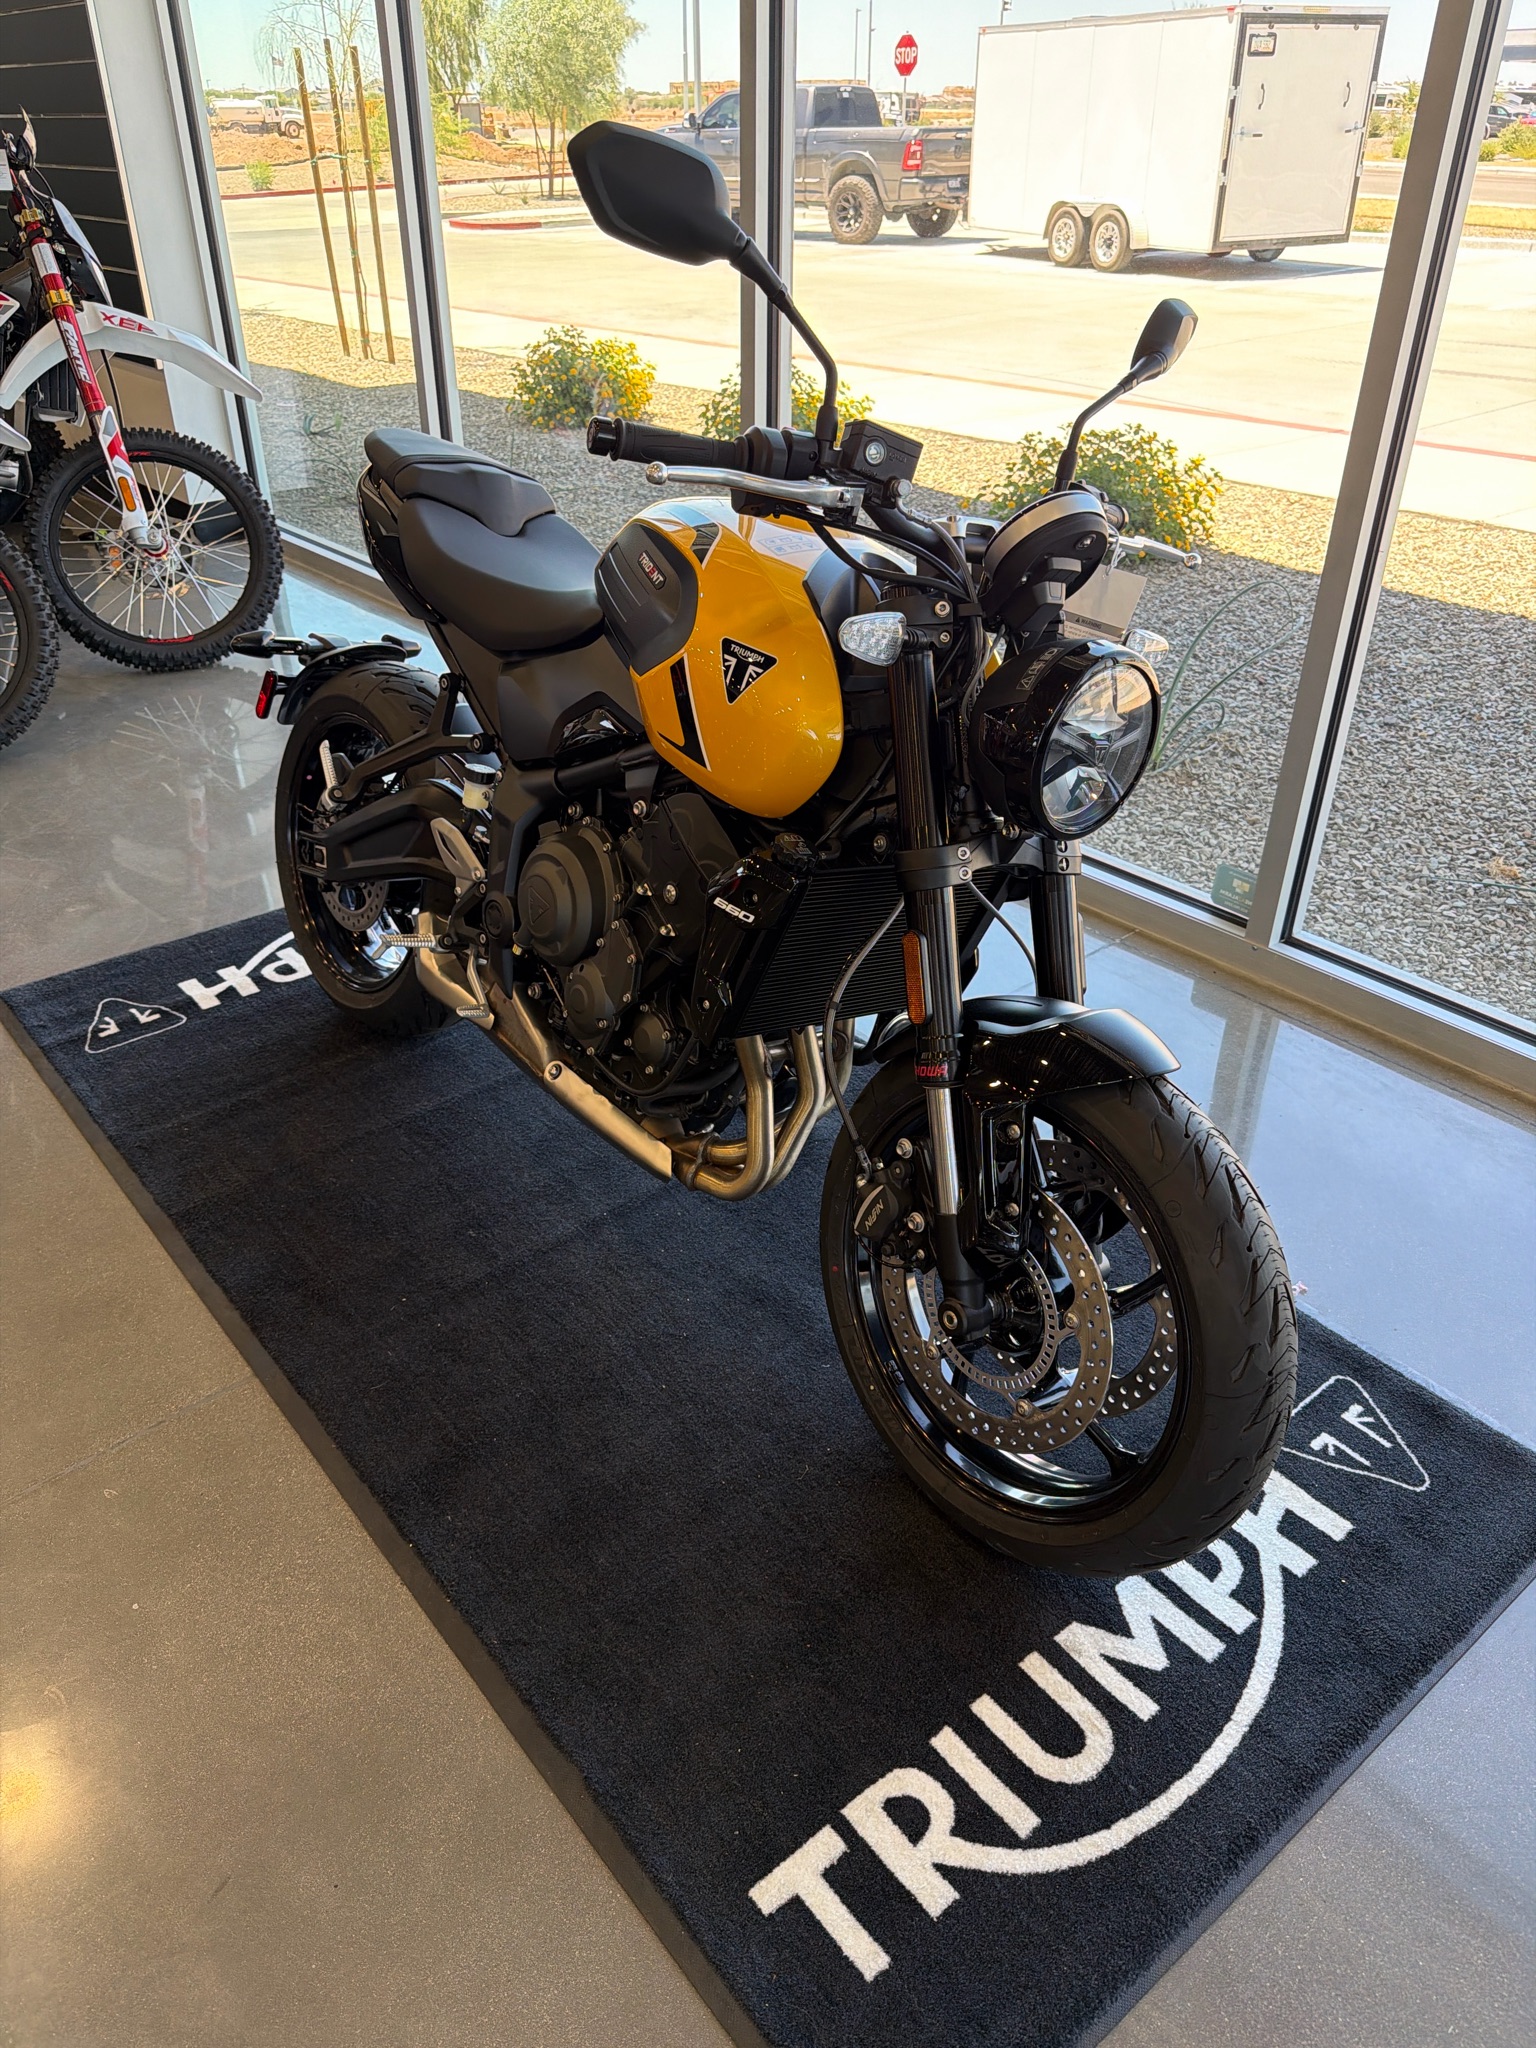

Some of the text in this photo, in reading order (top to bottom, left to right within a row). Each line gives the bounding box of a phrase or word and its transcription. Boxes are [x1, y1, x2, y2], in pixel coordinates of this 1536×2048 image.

[895, 46, 917, 65] STOP
[63, 321, 92, 384] FANTIC
[639, 552, 664, 584] TRIDENT
[1081, 618, 1102, 629] WARNING
[730, 643, 765, 664] TRIUMPH
[713, 896, 756, 924] 660
[914, 1063, 949, 1077] HOWA
[864, 1198, 884, 1232] NISSIN
[747, 1470, 1355, 1982] TRIUMPH
